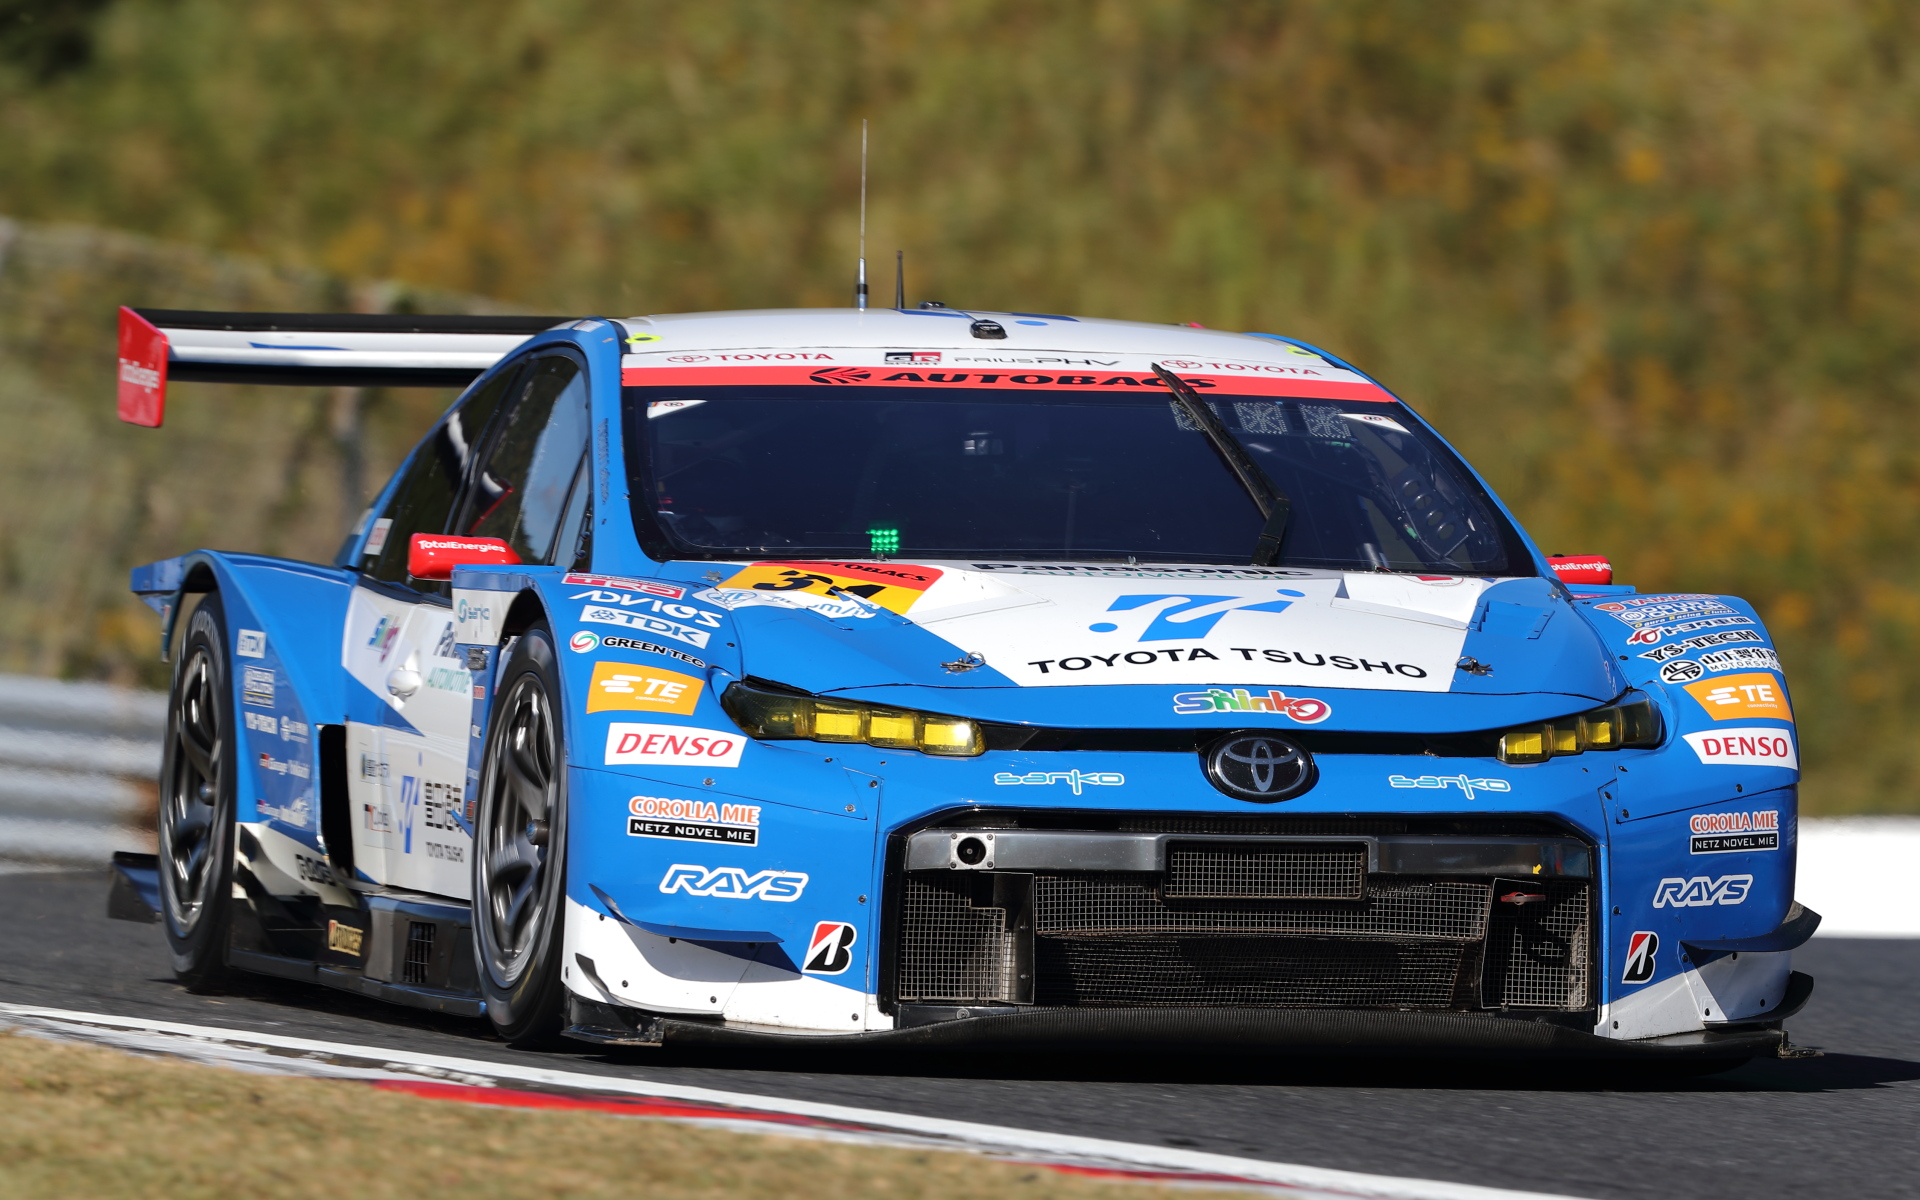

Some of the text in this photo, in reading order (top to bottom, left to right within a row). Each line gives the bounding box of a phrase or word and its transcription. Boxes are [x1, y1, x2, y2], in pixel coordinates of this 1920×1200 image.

[714, 352, 835, 362] TOYOTA
[882, 373, 1217, 388] AUTOBACS
[1205, 363, 1322, 376] TOYOTA
[418, 540, 507, 553] TotalEnergies
[970, 563, 1315, 577] Panasonic
[1550, 561, 1612, 572] otalEnergies
[617, 612, 702, 644] TDK
[603, 637, 704, 668] GREEN TEC
[1644, 630, 1759, 662] YS-TECH
[1027, 646, 1428, 679] TOYOTA TSUSHO
[643, 677, 688, 699] TE
[1739, 684, 1776, 702] TE
[1174, 689, 1331, 723] Shinko
[616, 733, 734, 757] DENSO
[1701, 736, 1789, 758] DENSO
[630, 798, 760, 825] COROLLA MIE
[1691, 811, 1778, 833] COROLLA MIE
[633, 822, 752, 841] NETZ NOVEL MIE
[1694, 836, 1775, 849] NETZ NOVEL MIE
[661, 865, 807, 901] RAYS
[1655, 876, 1752, 907] RAYS
